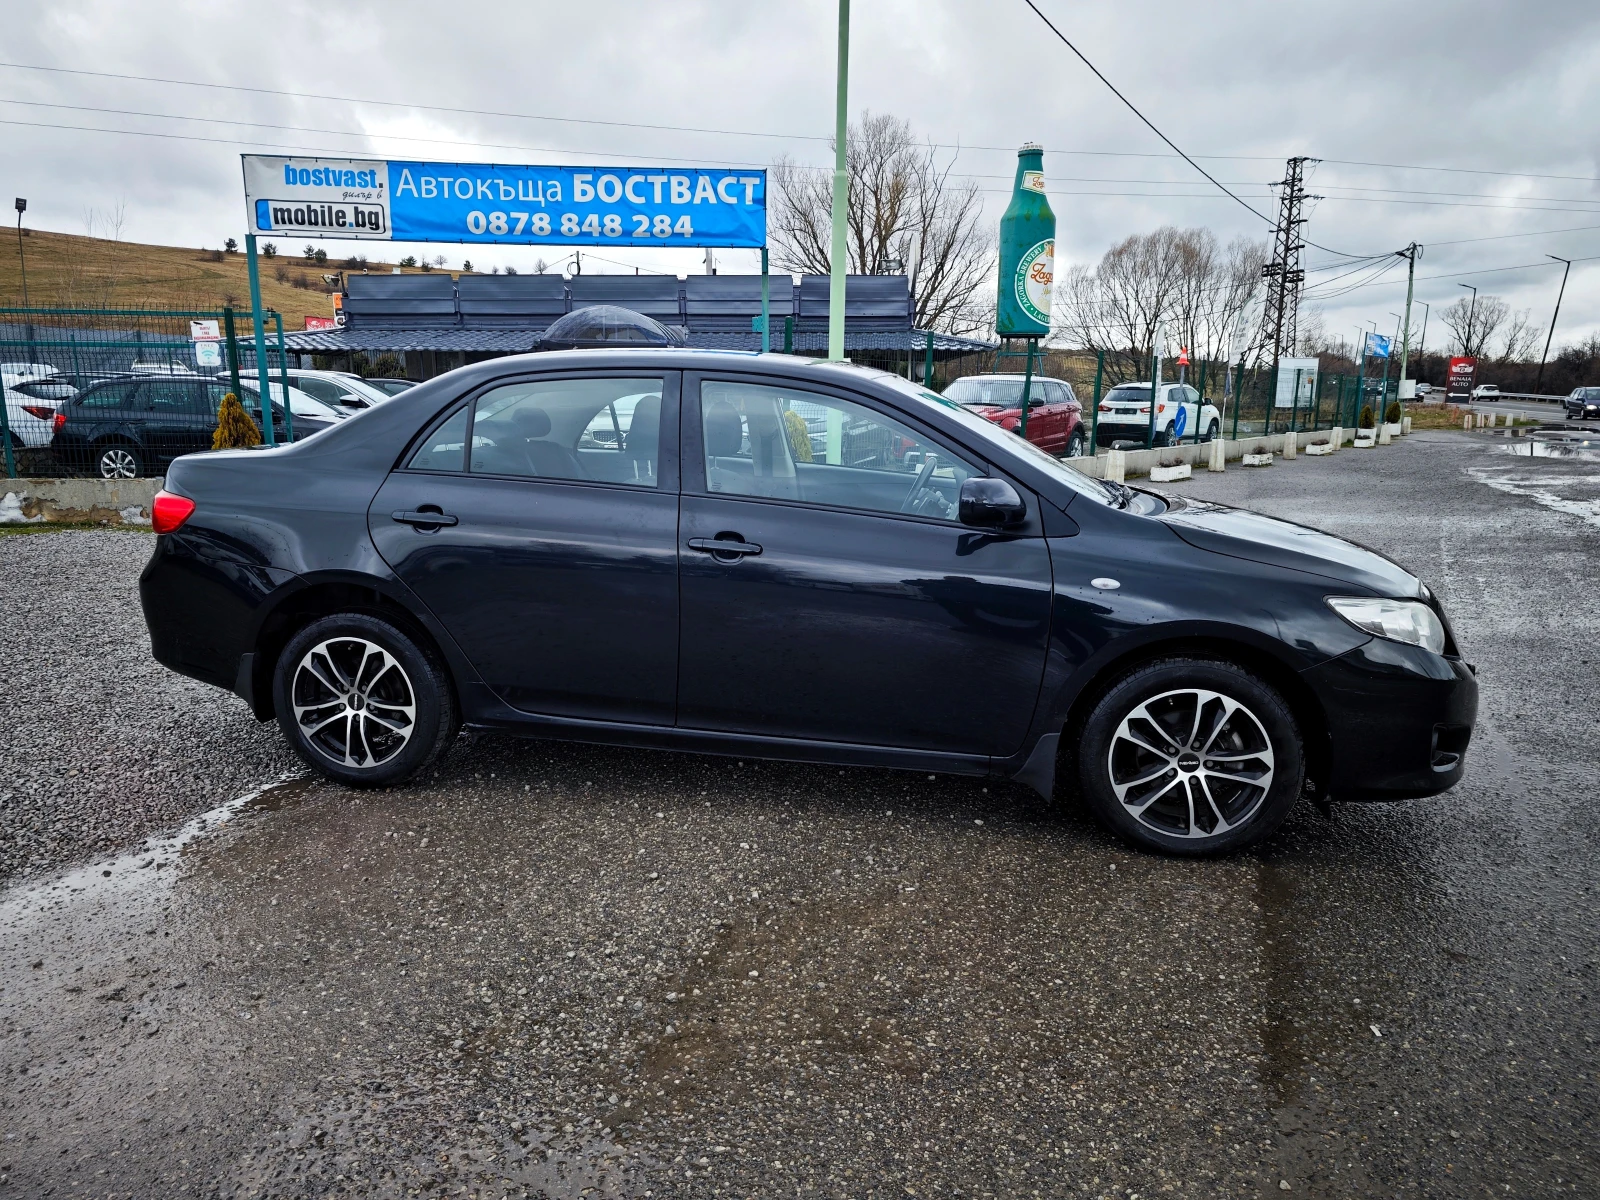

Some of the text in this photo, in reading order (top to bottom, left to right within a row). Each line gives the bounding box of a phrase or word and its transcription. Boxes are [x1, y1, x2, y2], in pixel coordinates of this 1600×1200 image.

[395, 168, 760, 207] Автокъща БОСТВАСТ
[272, 204, 380, 231] mobile.bg
[466, 210, 694, 239] 0878 848 284
[1020, 245, 1043, 275] BREWERY
